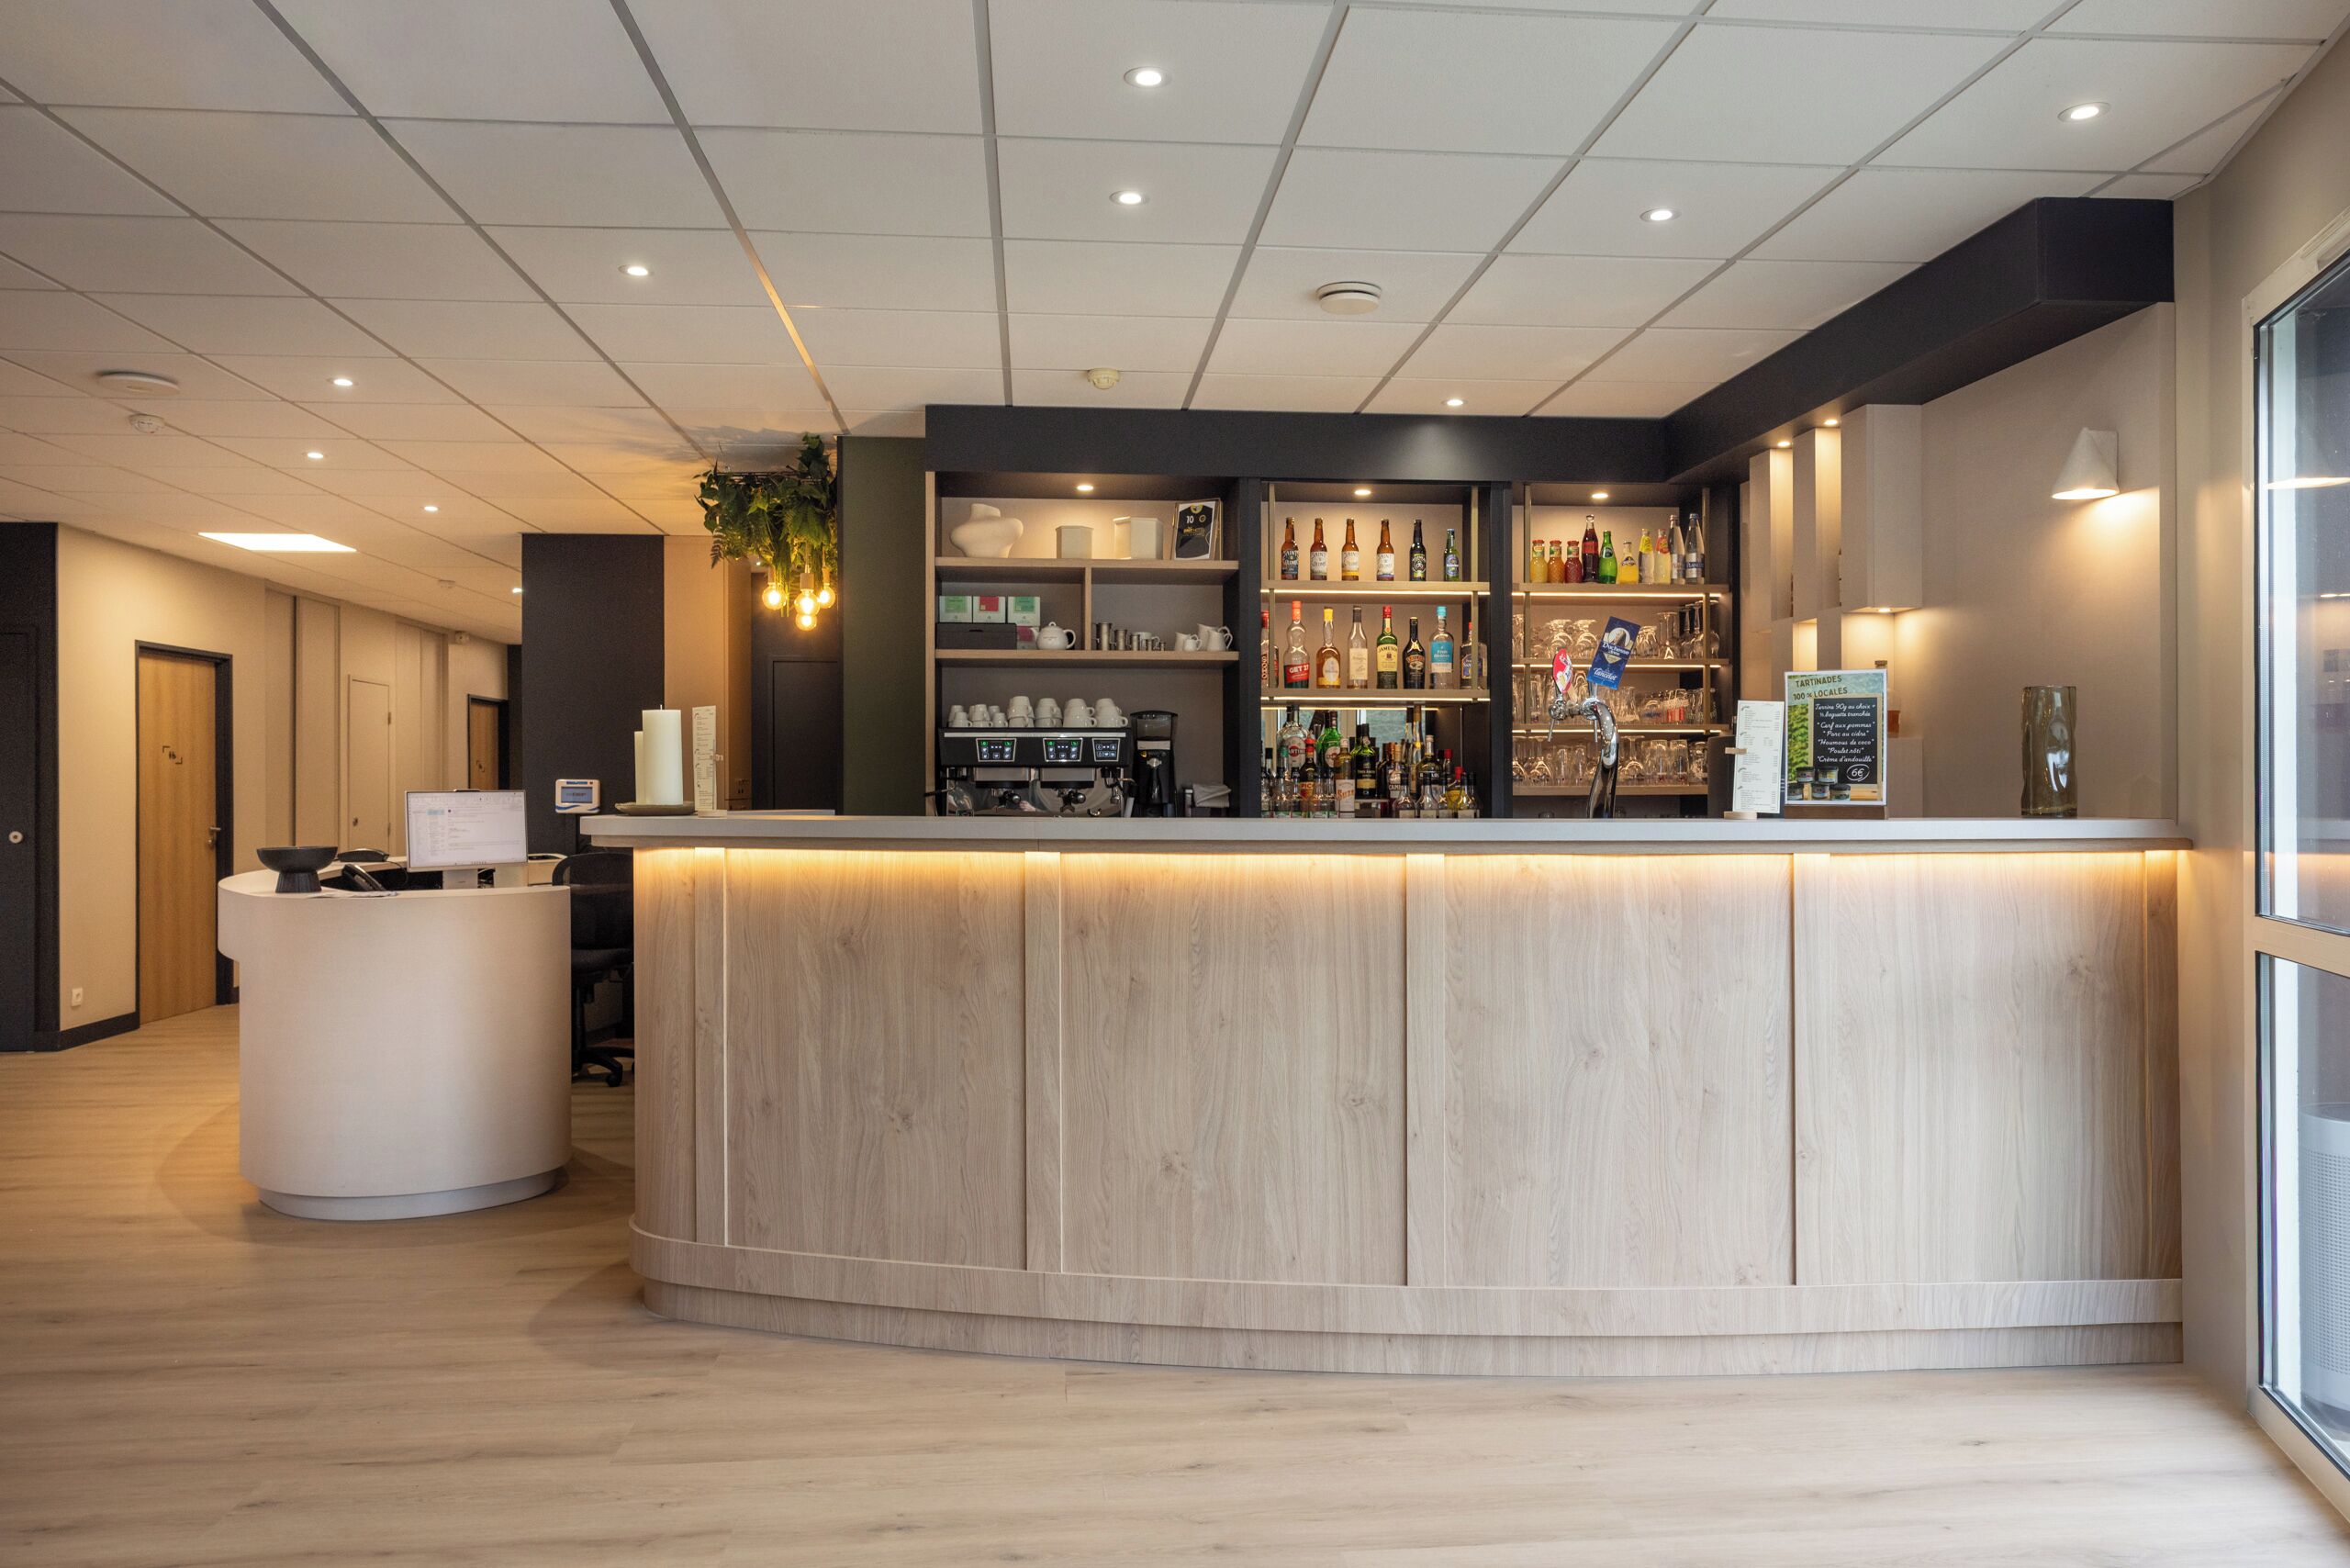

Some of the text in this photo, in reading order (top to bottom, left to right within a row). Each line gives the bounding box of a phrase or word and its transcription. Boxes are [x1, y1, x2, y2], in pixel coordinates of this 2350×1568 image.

[1186, 515, 1194, 524] 10
[1602, 642, 1629, 655] Duchesse
[1289, 666, 1303, 674] GET
[1796, 675, 1842, 688] TARTINADES
[1793, 692, 1806, 700] 100
[1813, 687, 1848, 698] LOCALES
[1835, 703, 1847, 711] 90g
[1824, 711, 1847, 719] baguette
[1851, 767, 1864, 777] 6€
